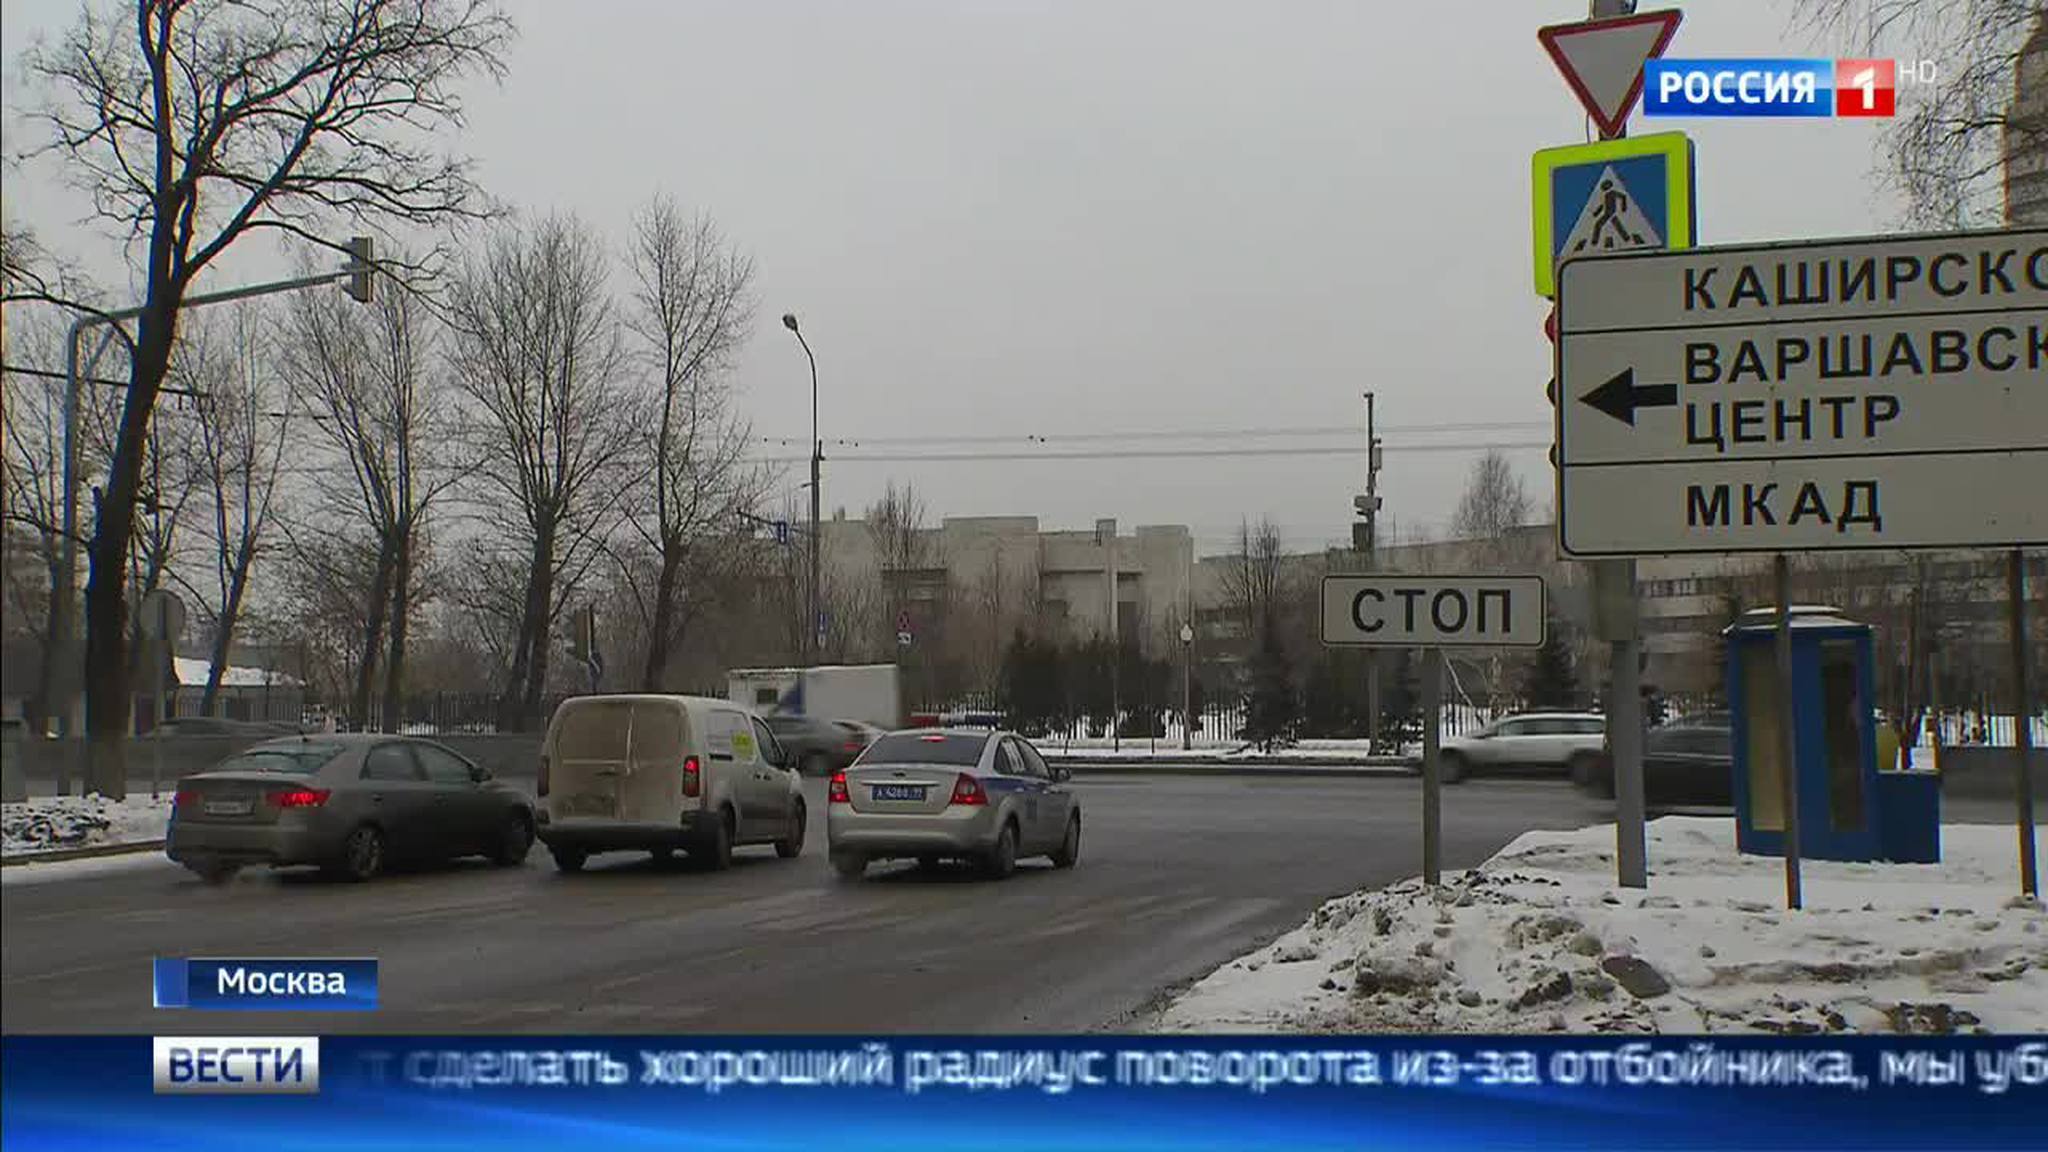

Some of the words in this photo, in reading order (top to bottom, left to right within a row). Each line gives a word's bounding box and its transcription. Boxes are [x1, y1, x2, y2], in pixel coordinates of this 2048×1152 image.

[1686, 394, 1900, 453] ЦЕНТР
[1687, 481, 1882, 533] МКАД
[1352, 588, 1511, 634] СТОП
